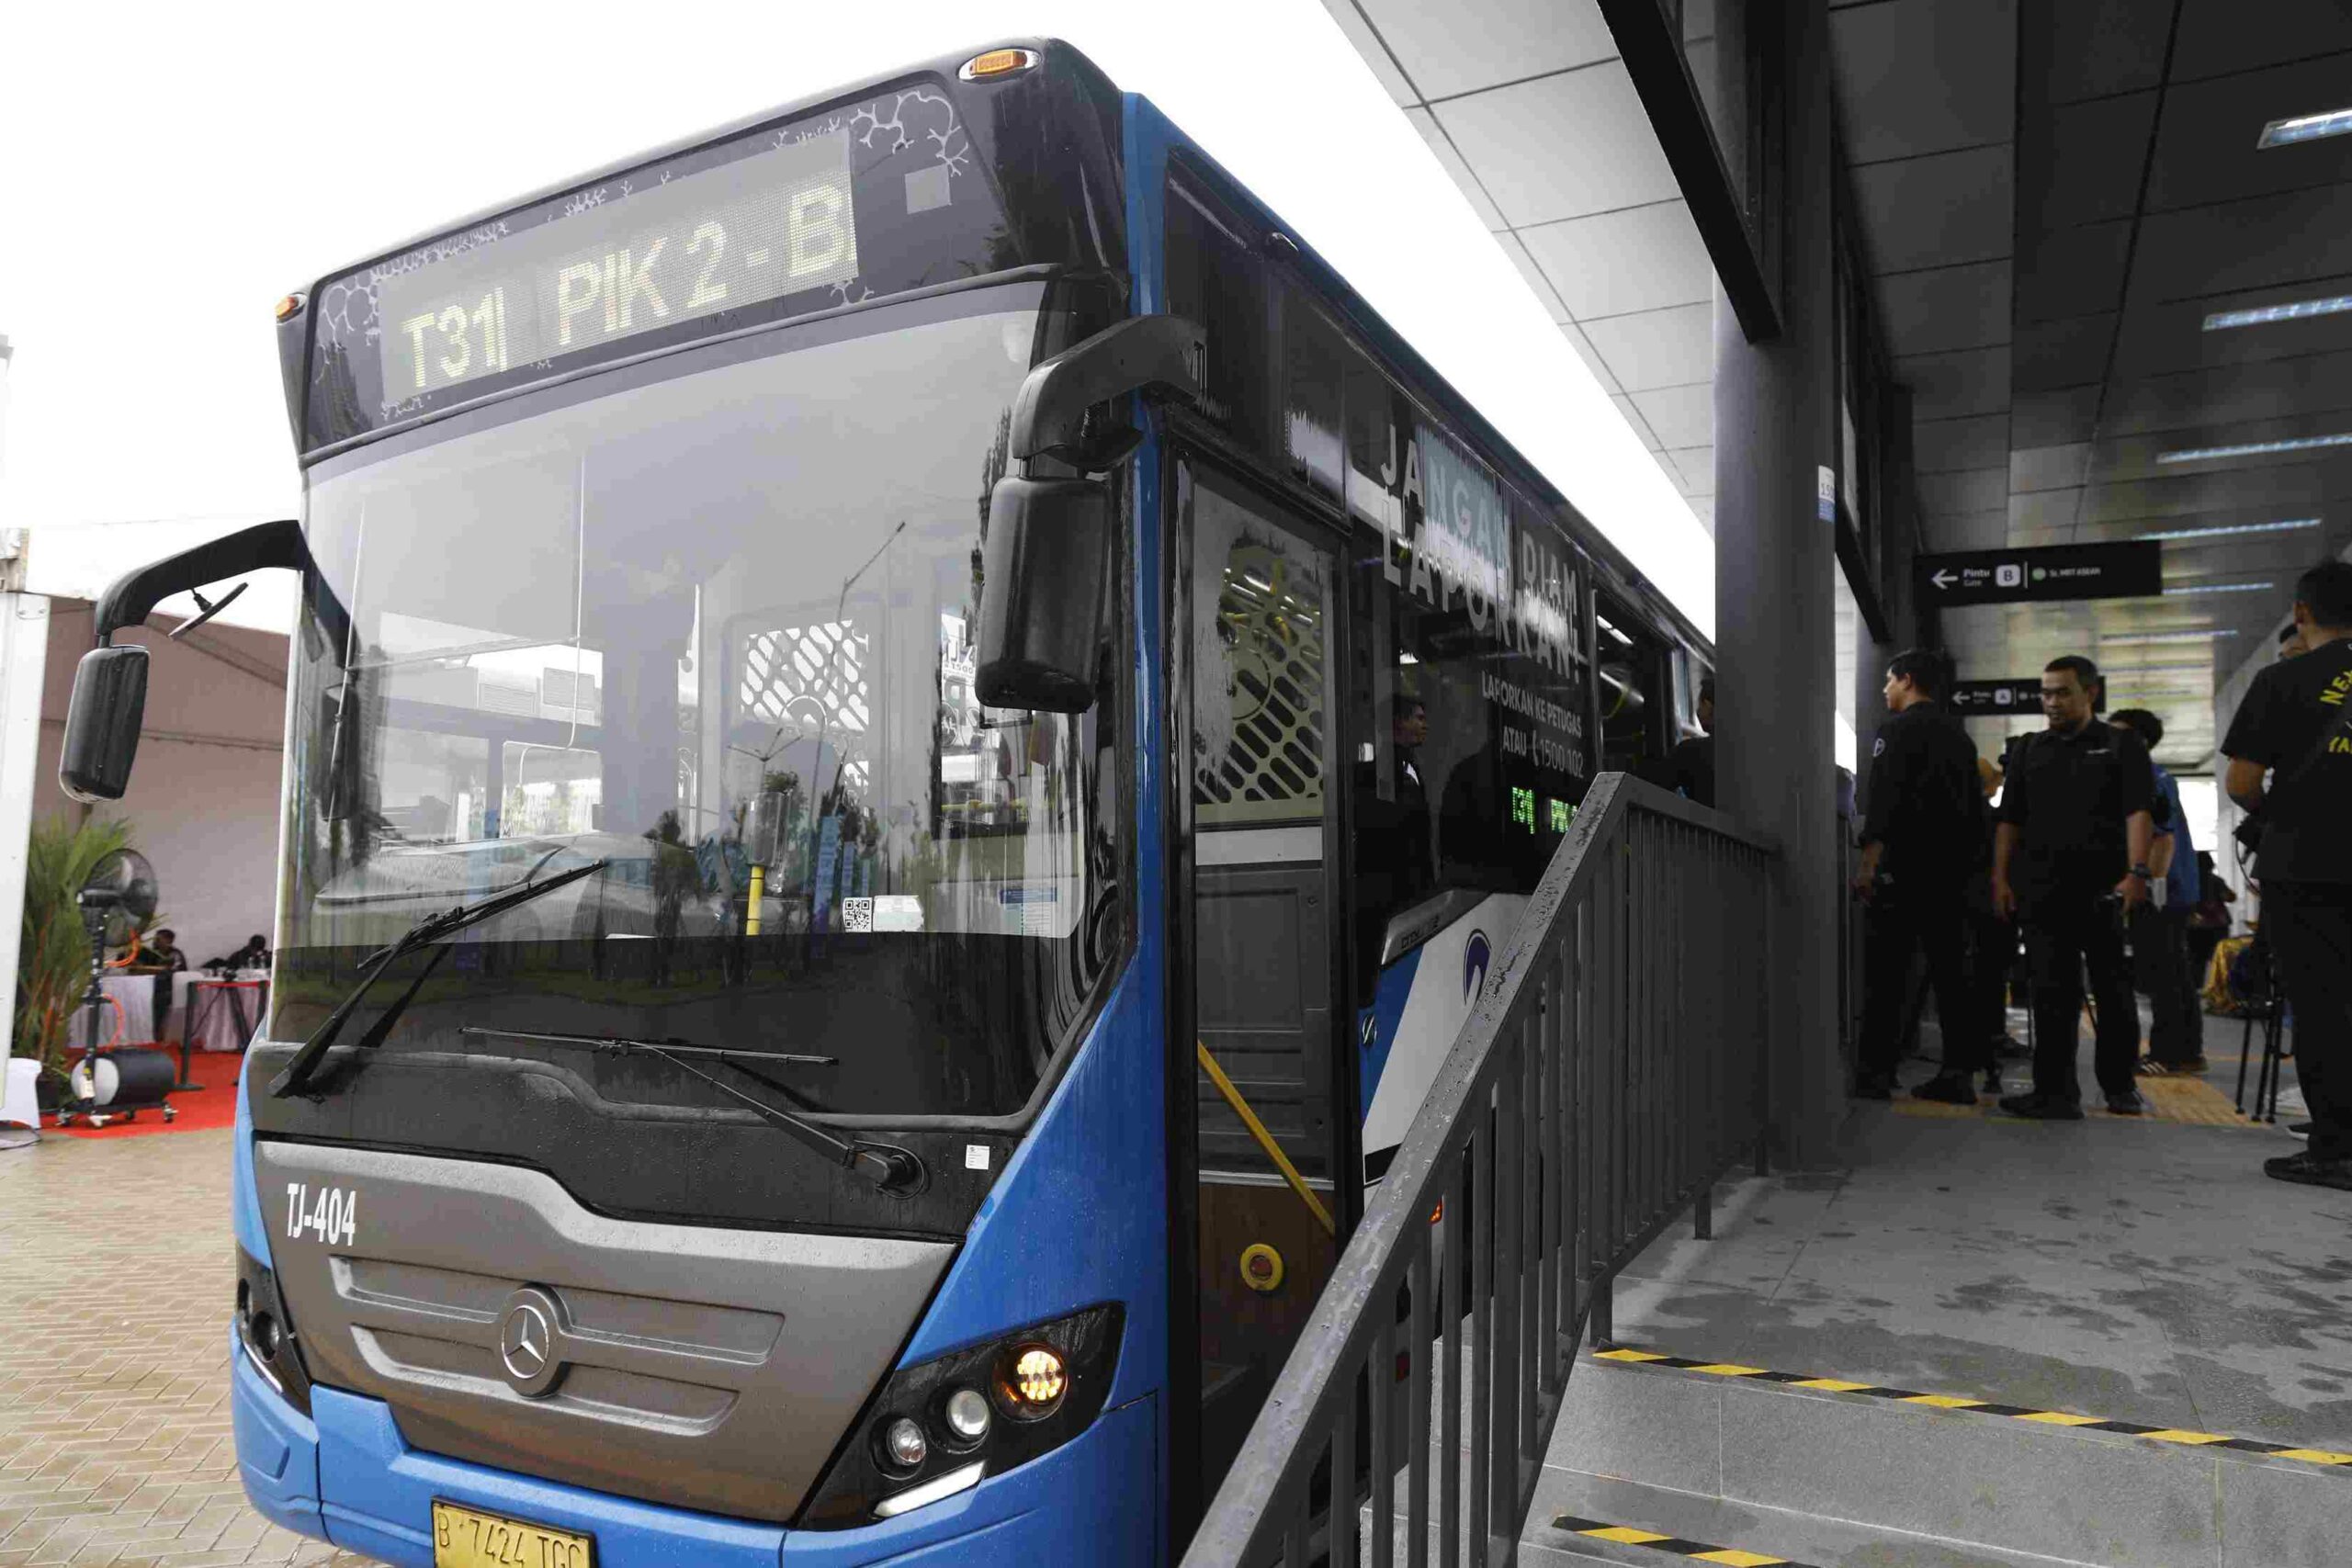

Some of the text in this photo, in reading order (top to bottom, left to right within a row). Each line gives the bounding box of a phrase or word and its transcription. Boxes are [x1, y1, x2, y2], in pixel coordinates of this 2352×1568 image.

[558, 236, 671, 346] PIK
[686, 220, 728, 308] 2
[746, 248, 769, 267] -
[788, 186, 844, 276] B
[1380, 423, 1577, 615] JANGAN DIAM
[1962, 567, 1990, 579] Pintu
[1481, 669, 1582, 739] LAPORKAN KE PETUGAS
[1502, 726, 1526, 757] ATAU
[287, 1182, 356, 1246] TJ-404
[438, 1513, 450, 1547] B
[469, 1518, 524, 1565] 7424
